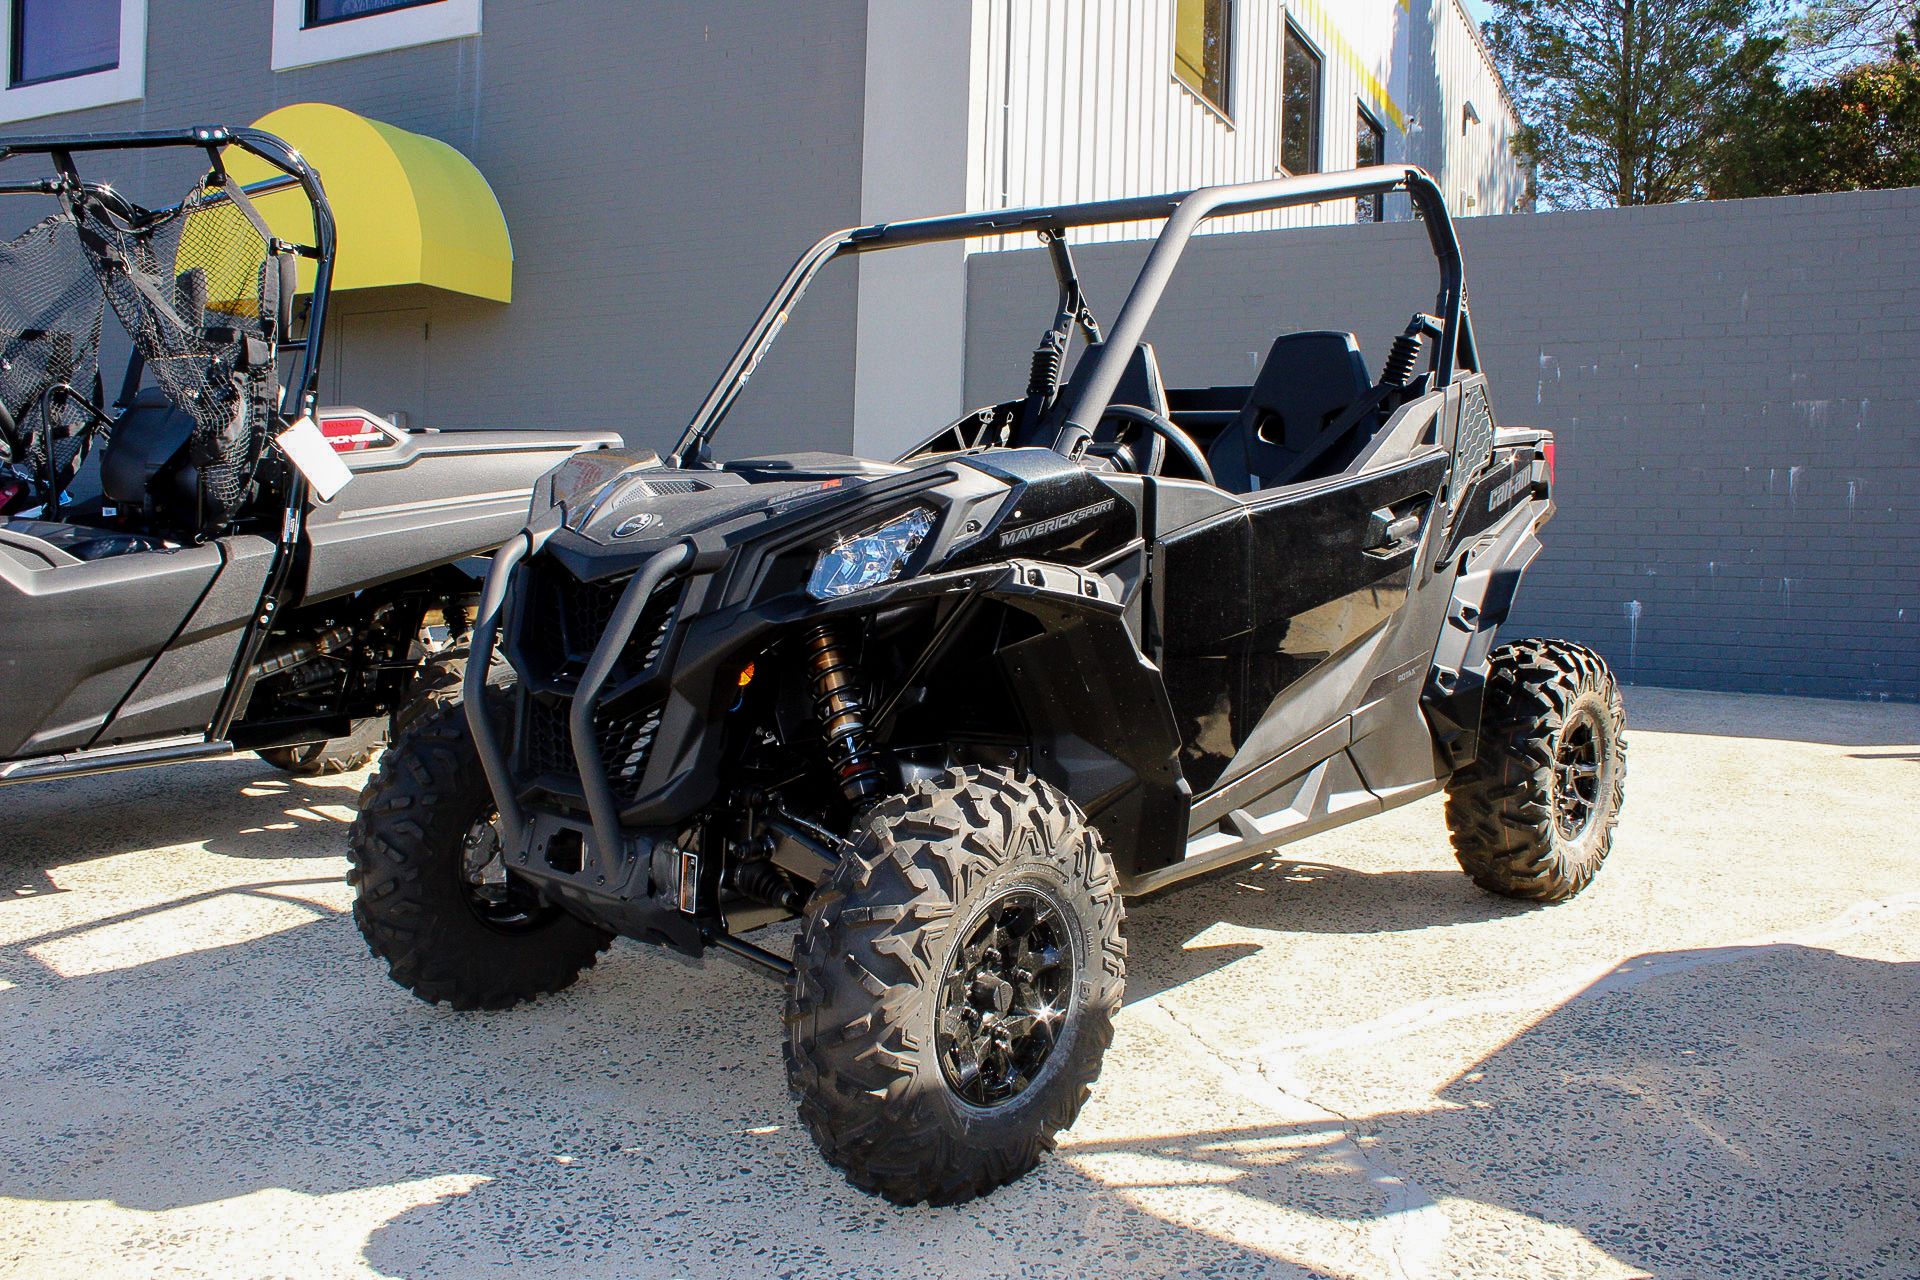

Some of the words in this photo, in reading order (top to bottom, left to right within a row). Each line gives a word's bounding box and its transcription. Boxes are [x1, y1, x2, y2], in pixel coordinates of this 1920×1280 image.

[1488, 463, 1532, 513] can-am
[1000, 512, 1079, 547] MAVERICK
[1077, 500, 1116, 520] SPORT
